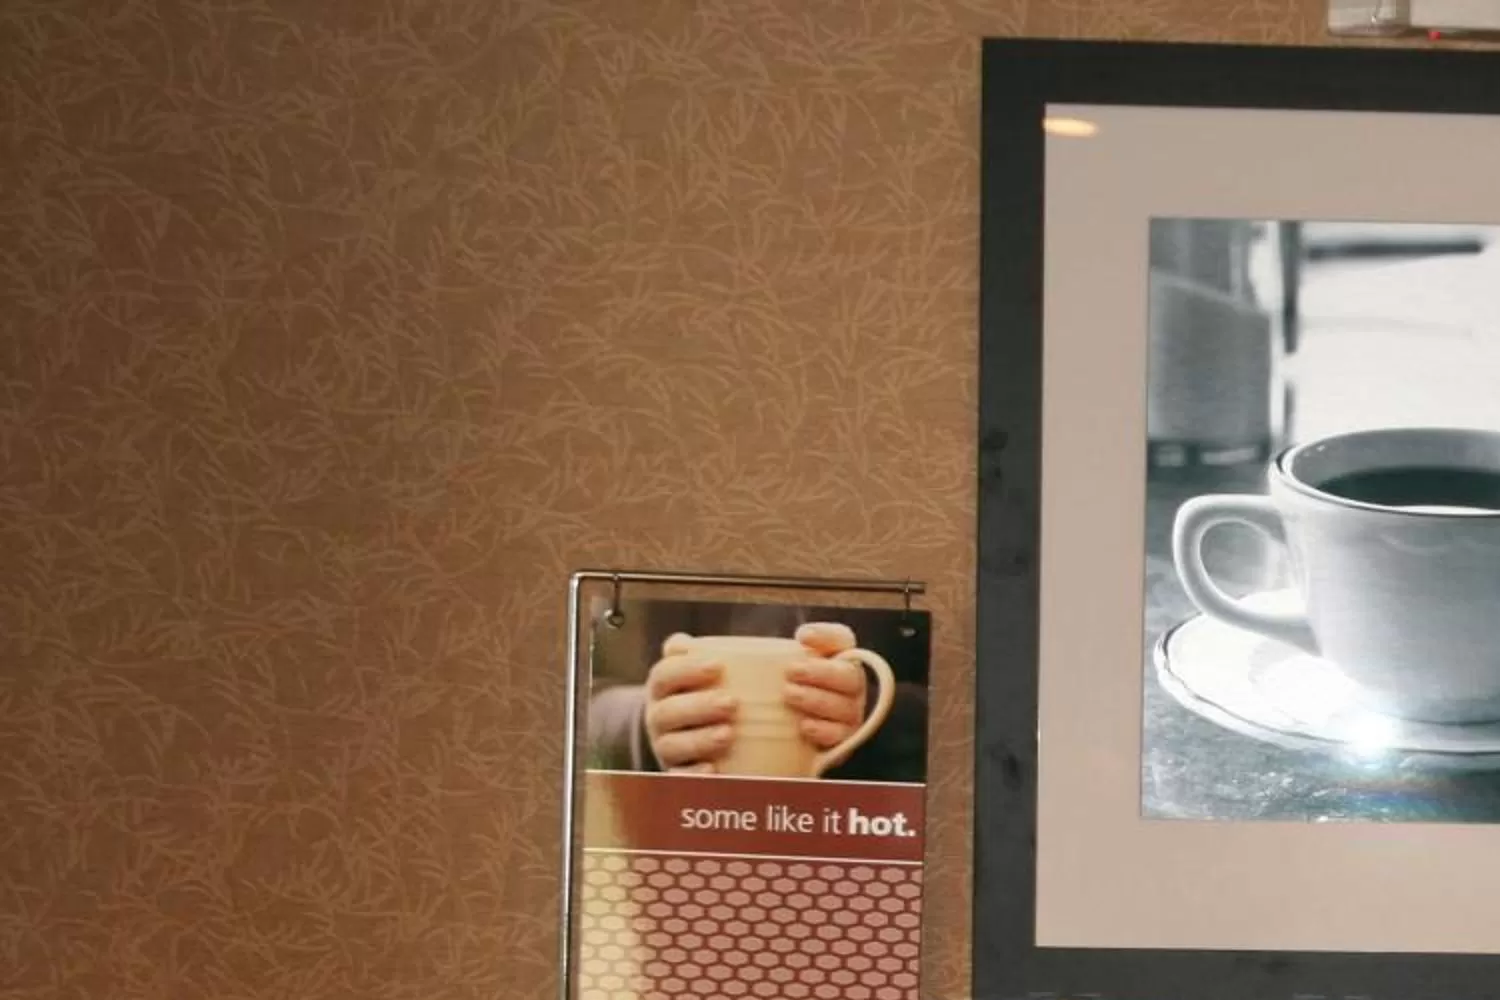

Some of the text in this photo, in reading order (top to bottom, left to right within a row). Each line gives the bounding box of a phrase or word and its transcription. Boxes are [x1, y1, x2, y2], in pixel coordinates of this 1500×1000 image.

[680, 804, 917, 838] some like it hot.
